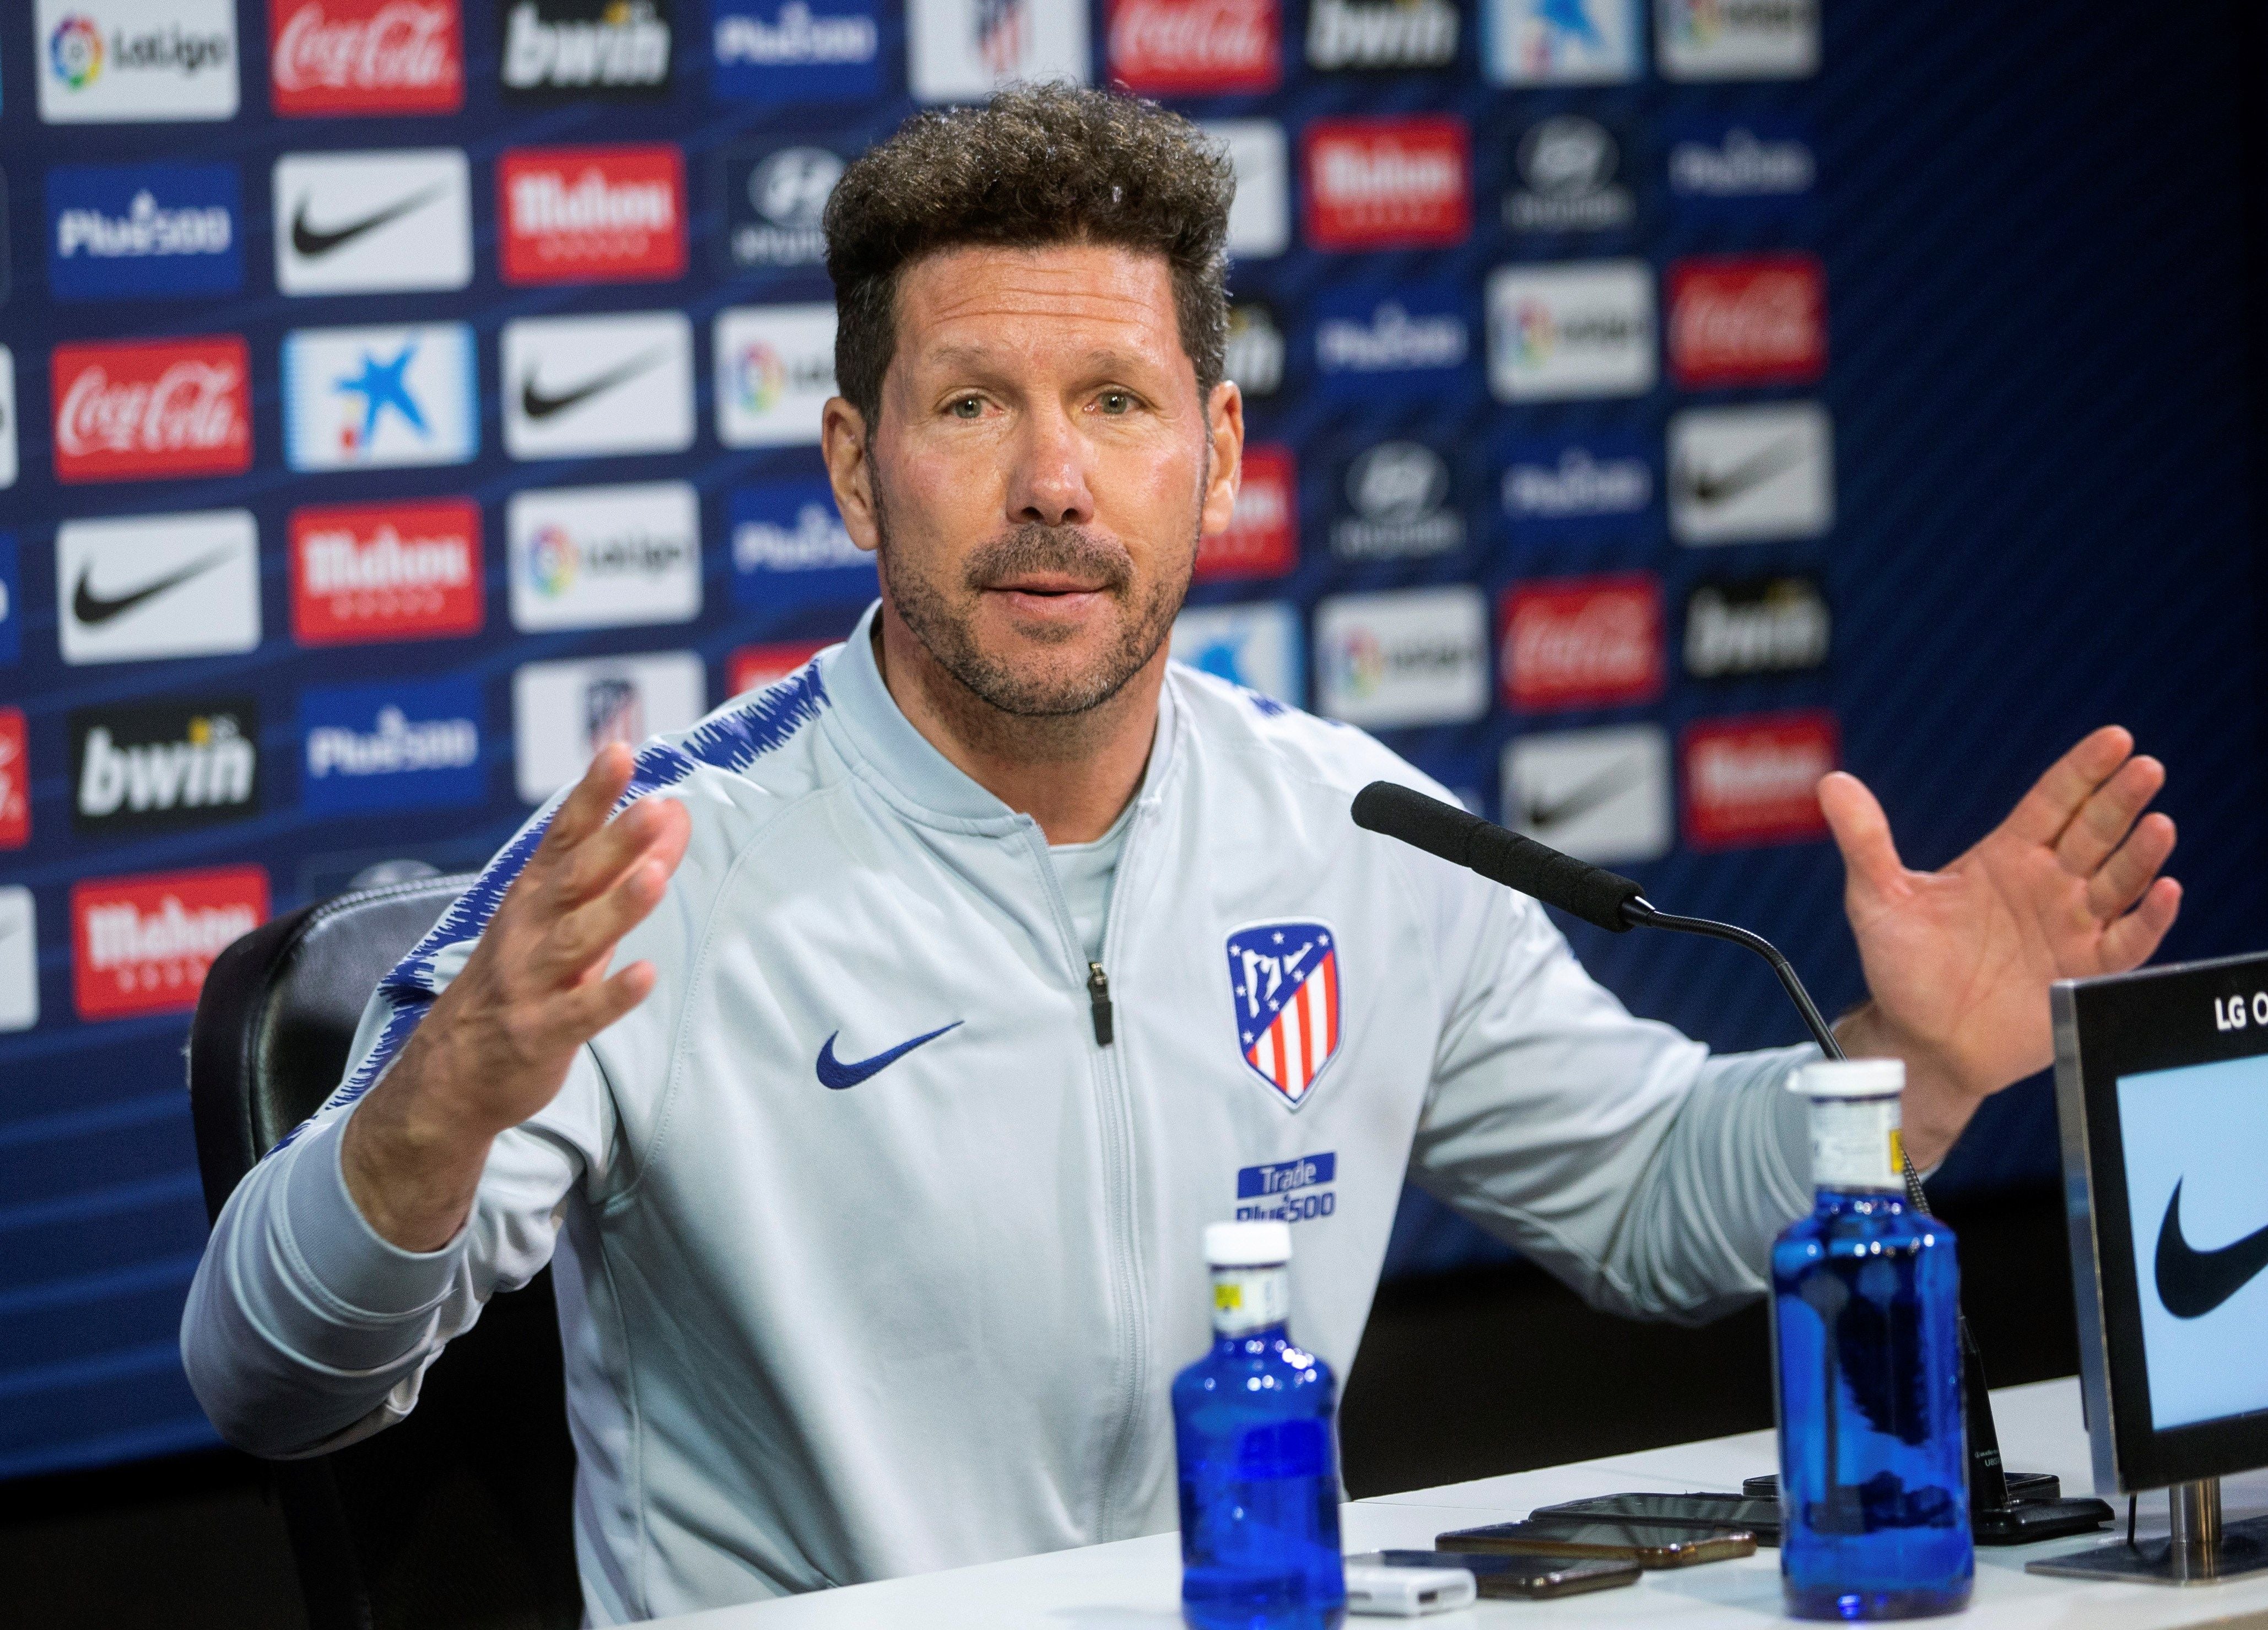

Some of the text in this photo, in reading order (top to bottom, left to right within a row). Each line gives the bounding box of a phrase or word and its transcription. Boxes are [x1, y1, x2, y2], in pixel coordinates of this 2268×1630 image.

[79, 717, 256, 816] bwin
[2215, 995, 2247, 1030] LG
[1259, 1158, 1317, 1194] Trade
